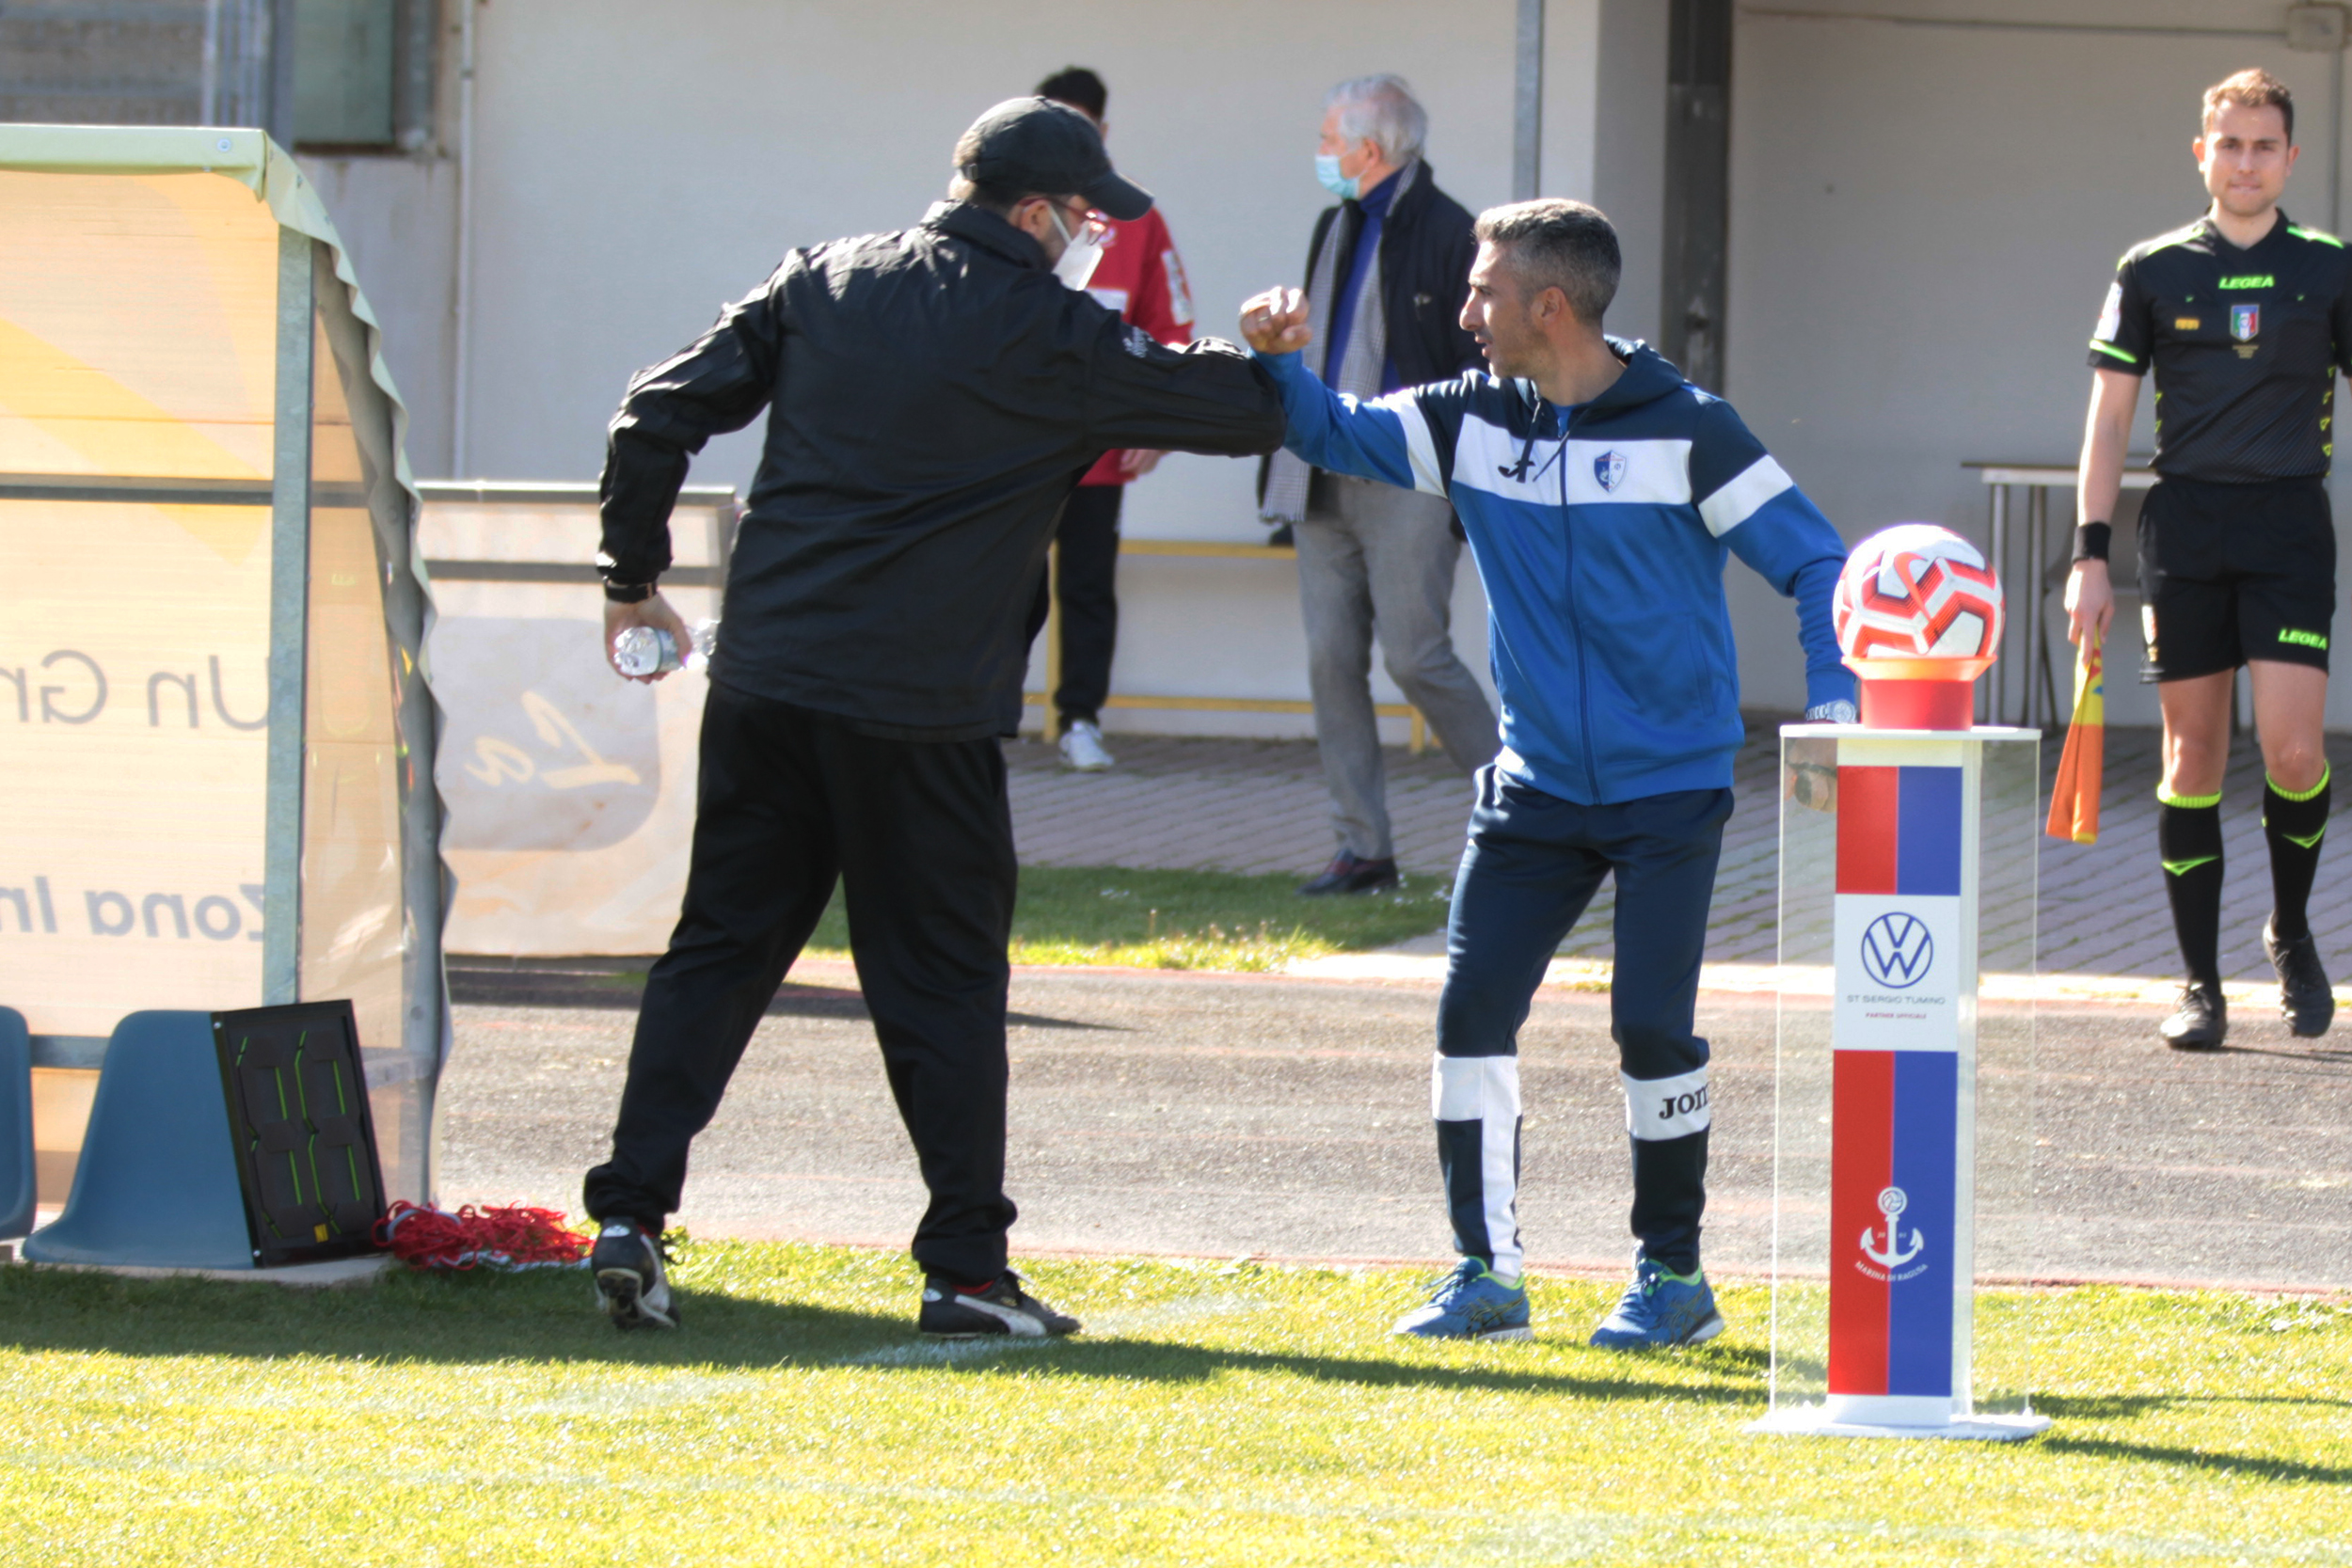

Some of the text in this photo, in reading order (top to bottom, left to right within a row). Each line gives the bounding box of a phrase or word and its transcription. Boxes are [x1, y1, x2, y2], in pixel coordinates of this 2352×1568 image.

[2218, 275, 2275, 290] LEGEA
[2278, 627, 2328, 651] LEGEA
[1659, 1082, 1710, 1120] JOM
[1854, 1259, 1886, 1282] MARINA
